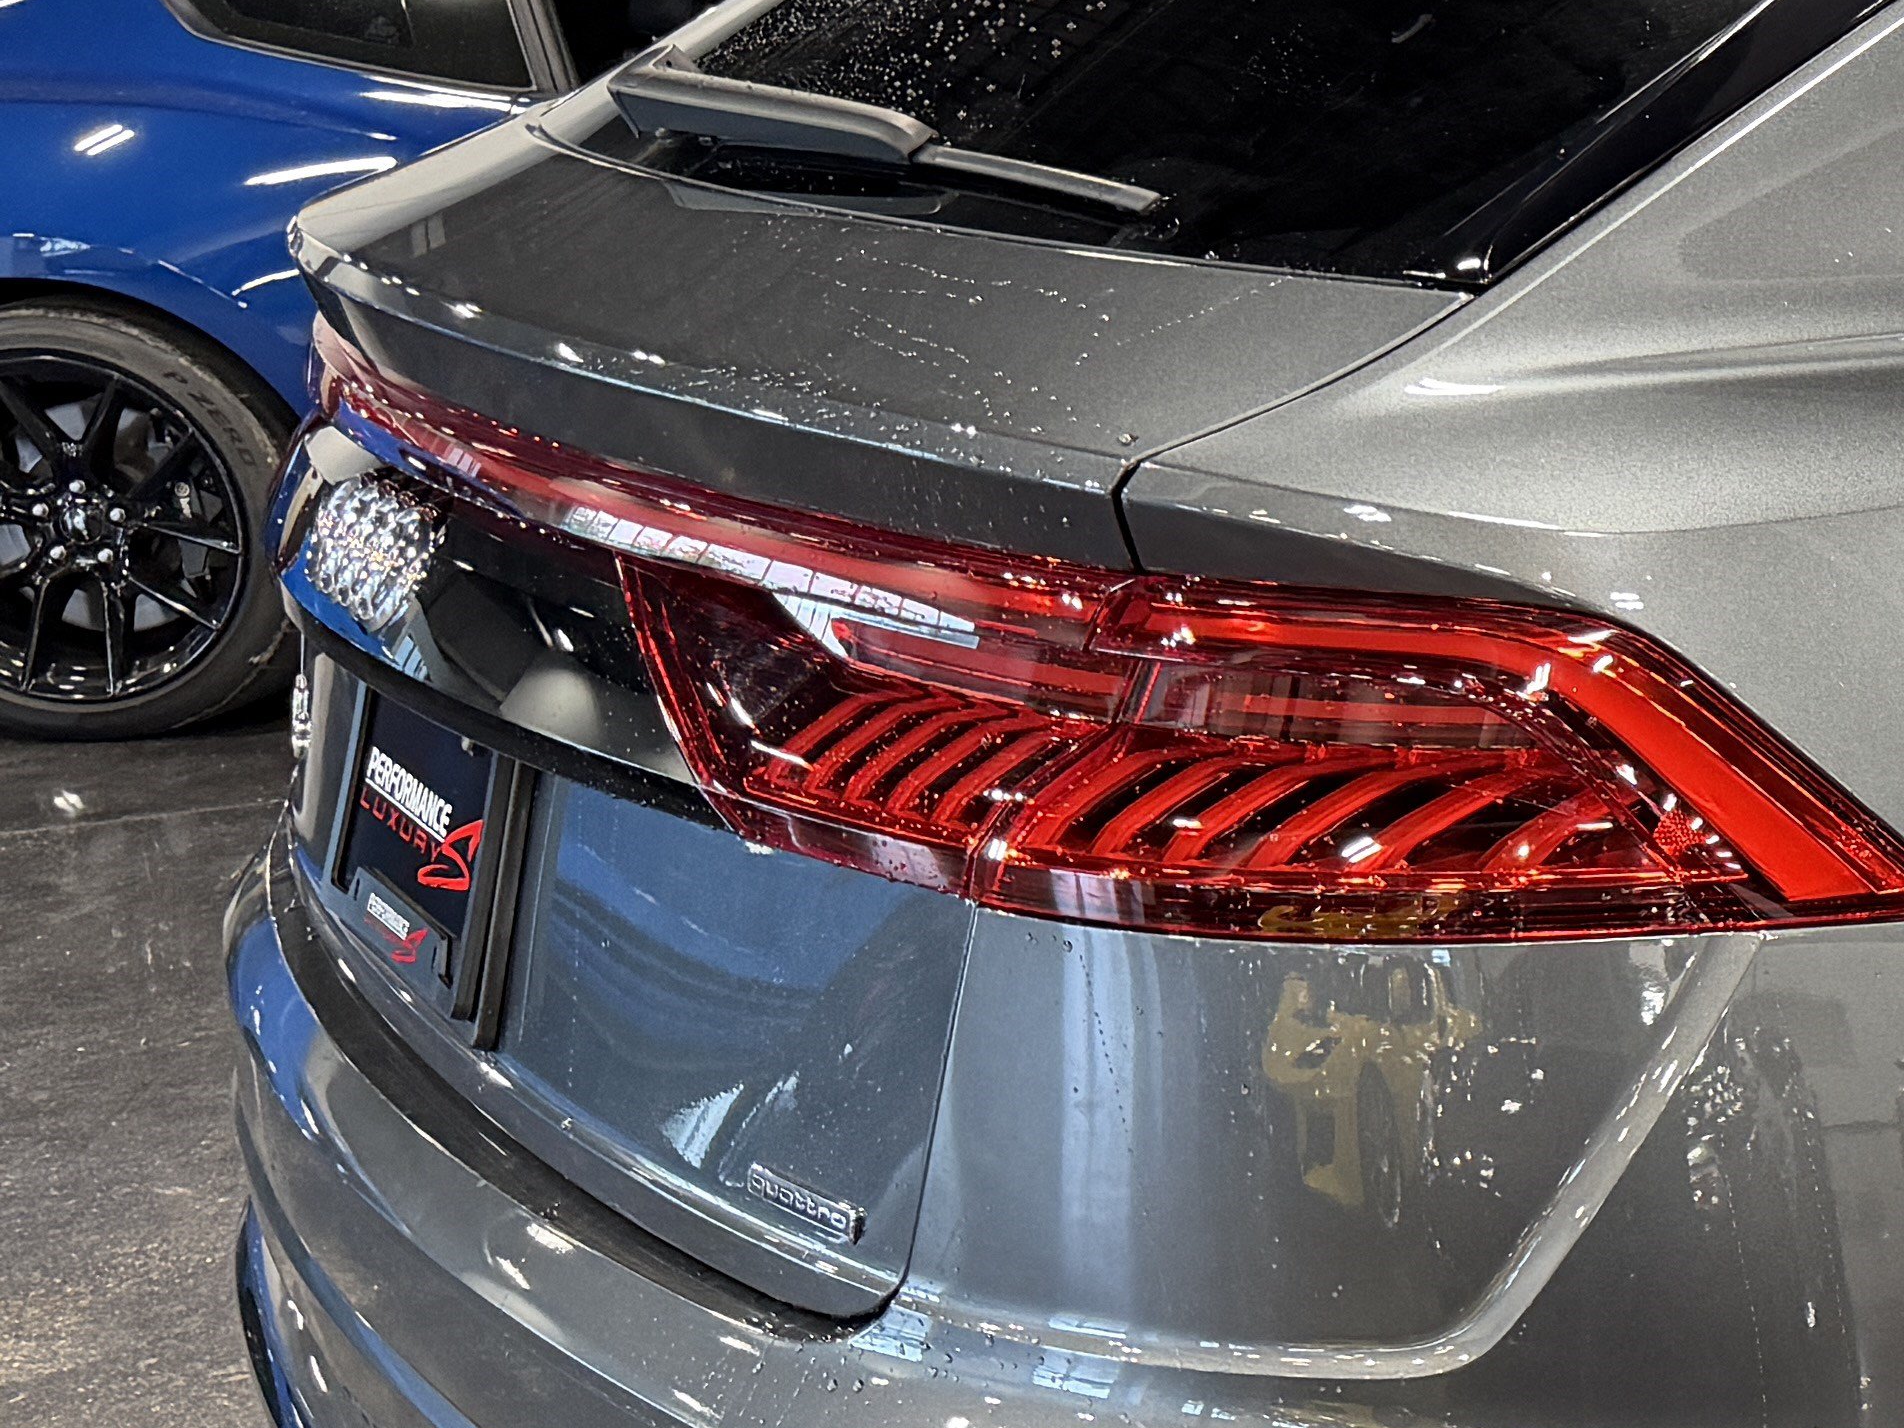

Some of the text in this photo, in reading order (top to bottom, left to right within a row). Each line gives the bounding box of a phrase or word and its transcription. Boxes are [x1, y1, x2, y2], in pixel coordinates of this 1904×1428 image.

[186, 391, 258, 468] ZERO
[359, 785, 443, 863] LUXURY
[365, 745, 453, 839] PERFORMANCE
[751, 1172, 847, 1230] quattro
